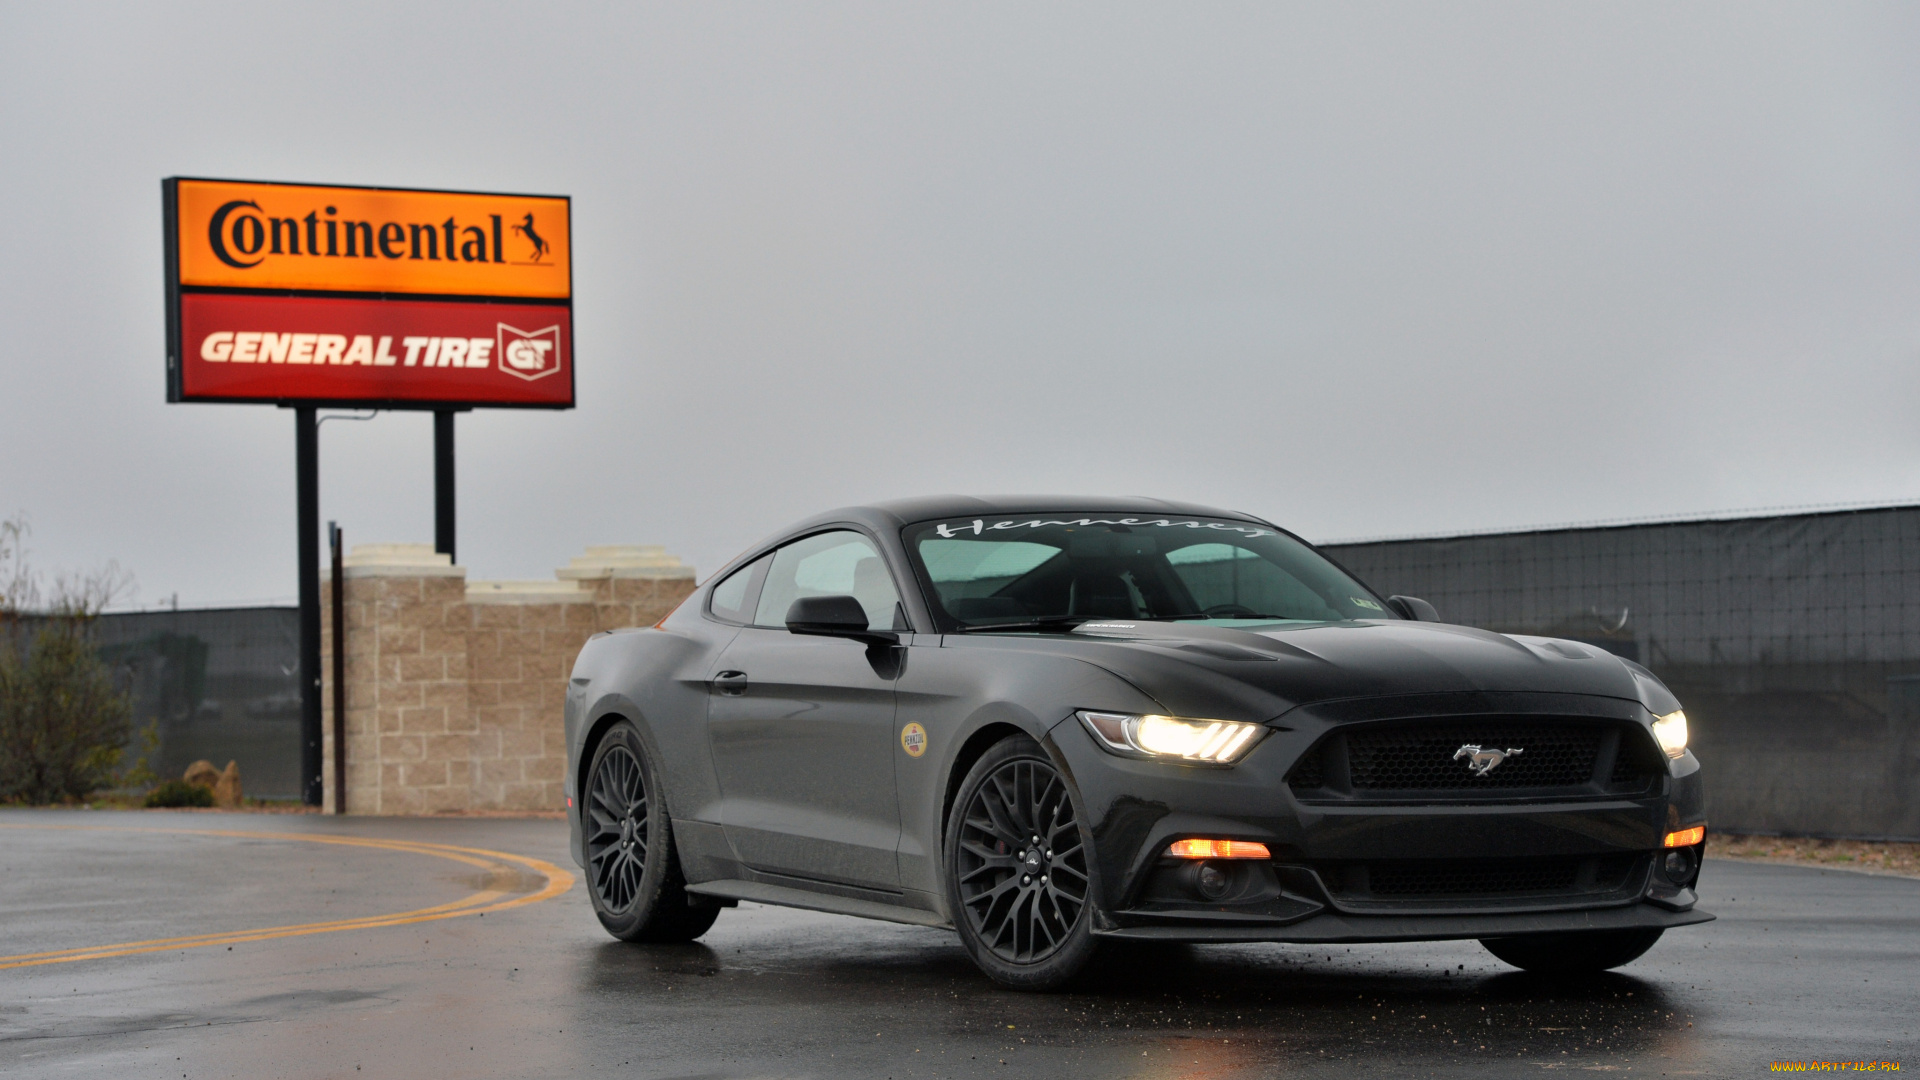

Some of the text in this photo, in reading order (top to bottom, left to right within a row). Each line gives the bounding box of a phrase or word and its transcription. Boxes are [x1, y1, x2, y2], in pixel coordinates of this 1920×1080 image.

[208, 199, 506, 269] Continental
[200, 331, 495, 368] GENERAL TIRE
[506, 339, 553, 369] GT
[936, 518, 1275, 538] Hennessey
